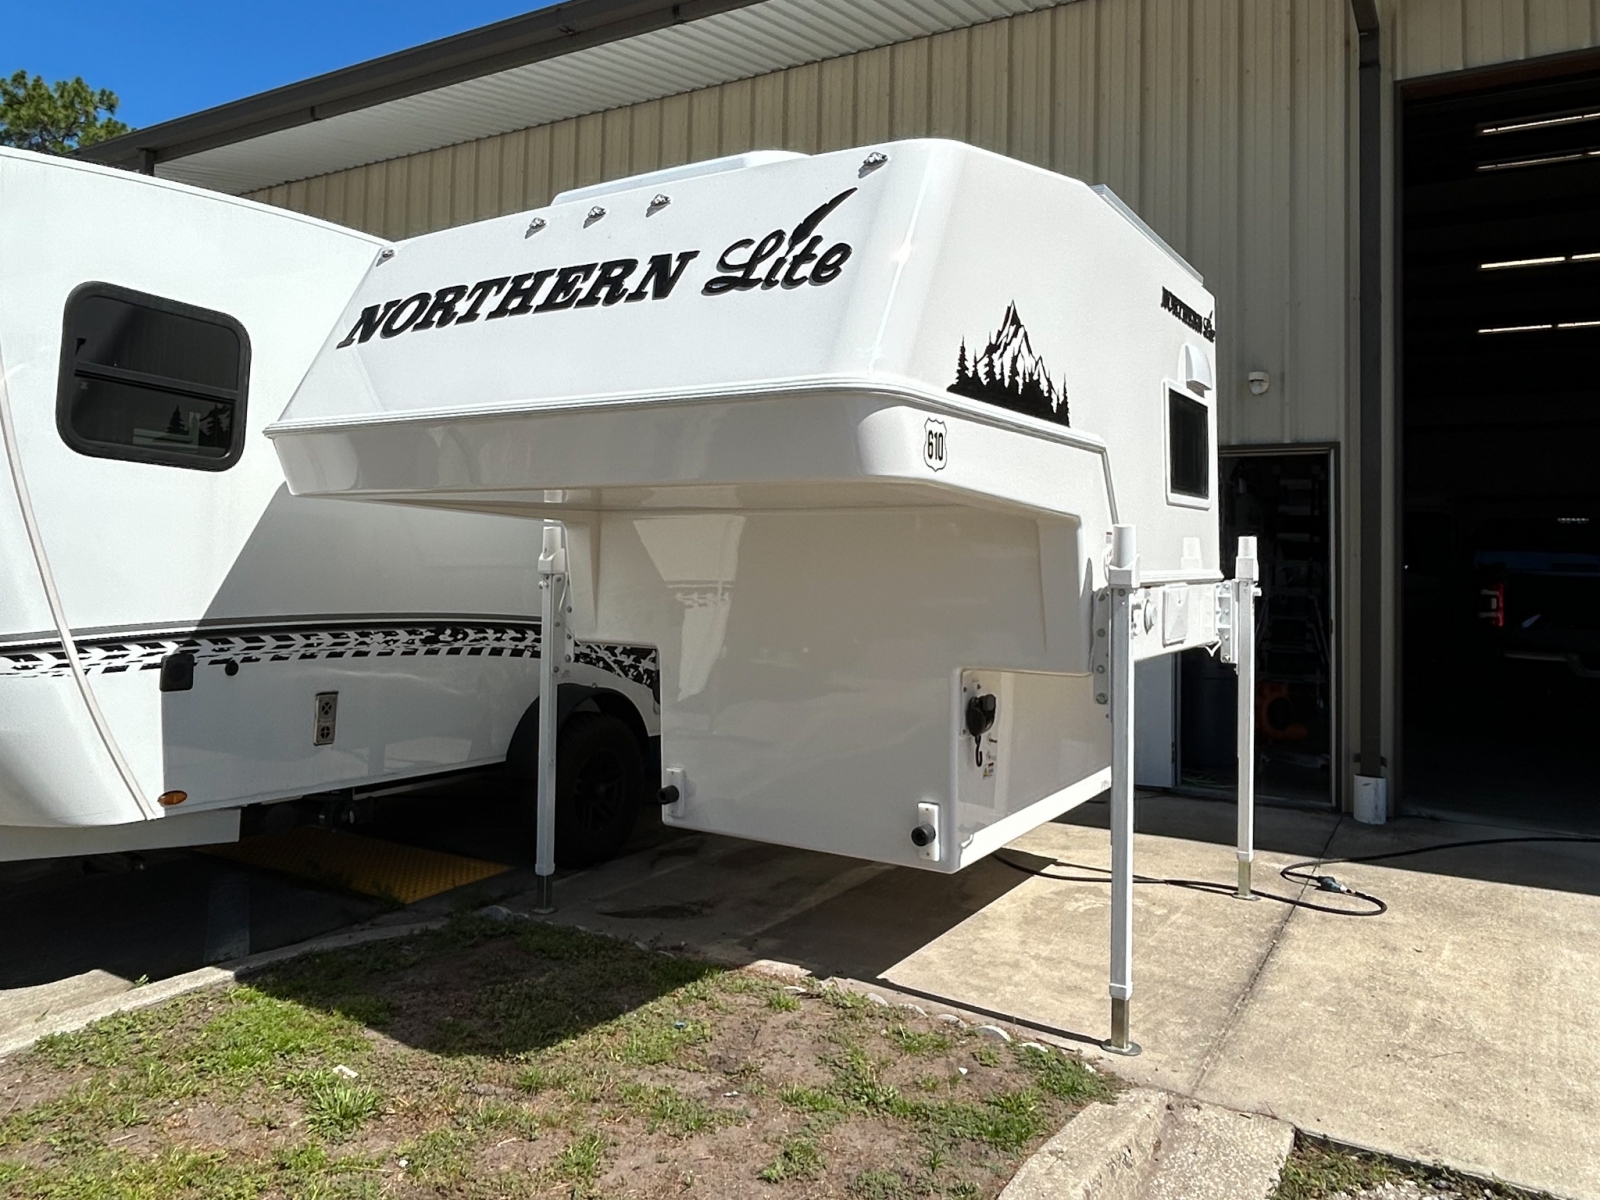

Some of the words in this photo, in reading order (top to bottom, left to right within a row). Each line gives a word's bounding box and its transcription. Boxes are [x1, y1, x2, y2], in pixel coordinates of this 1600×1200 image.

[336, 250, 700, 350] NORTHERN
[701, 187, 858, 297] Lite
[927, 429, 944, 462] 610
